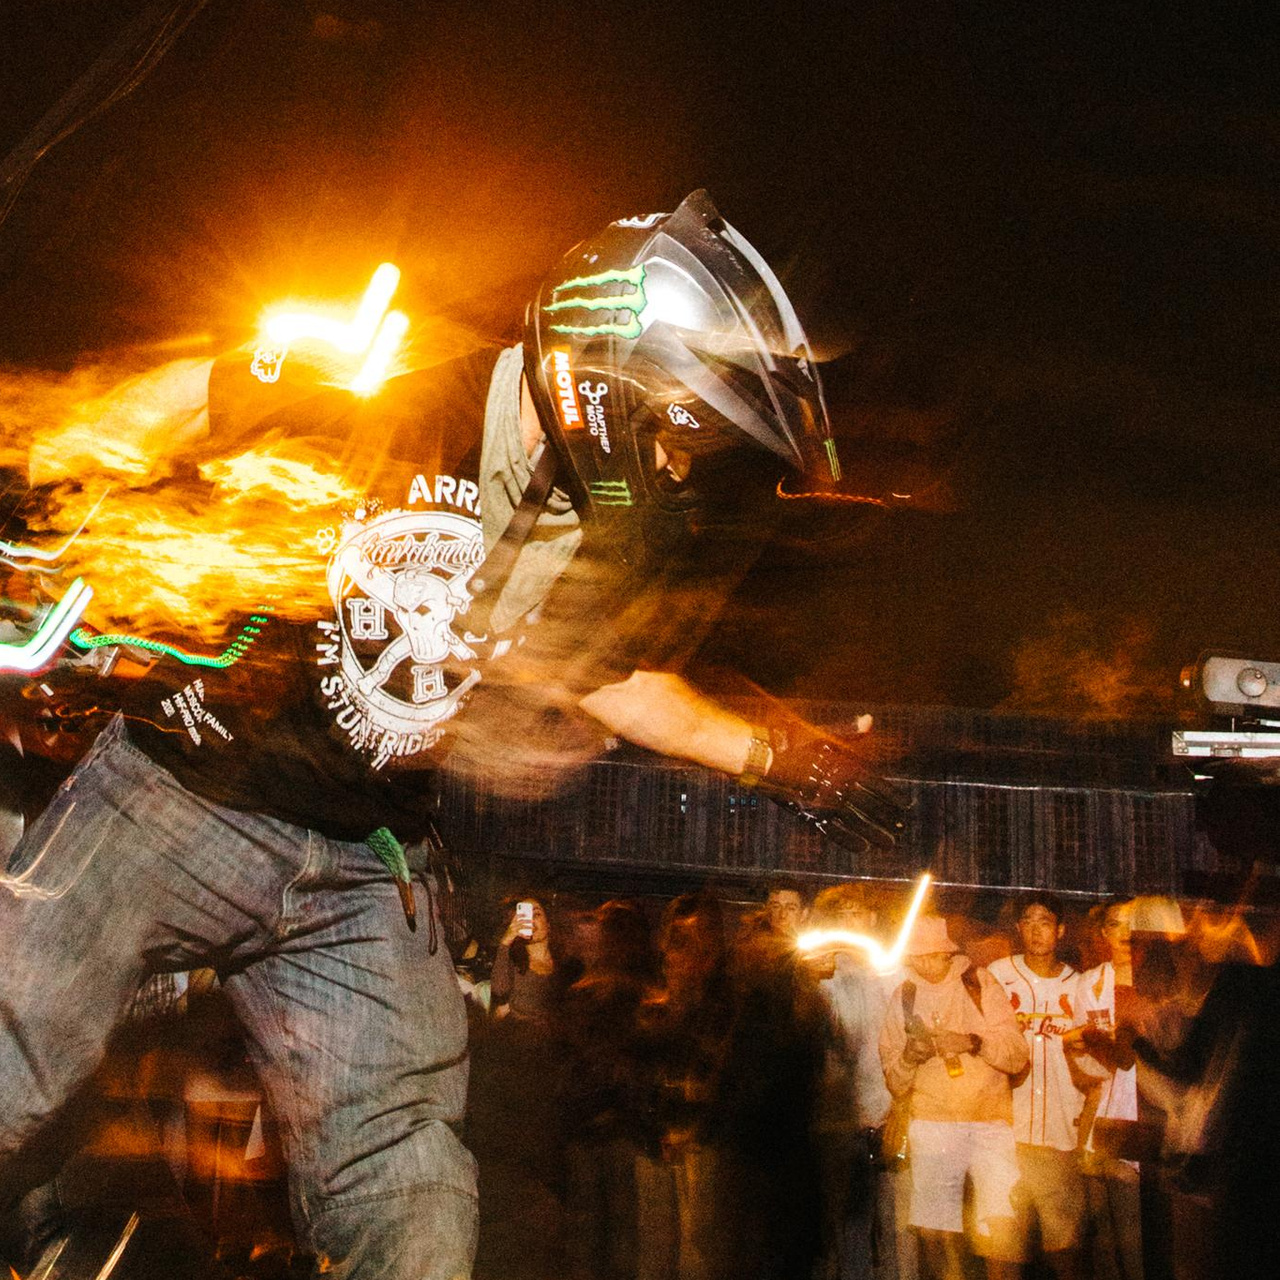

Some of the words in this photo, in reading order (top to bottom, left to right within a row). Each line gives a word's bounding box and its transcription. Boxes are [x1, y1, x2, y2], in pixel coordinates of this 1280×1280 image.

[554, 350, 580, 425] MOTUL
[316, 620, 340, 666] I'M
[203, 711, 234, 741] FAMILY
[1035, 1016, 1067, 1040] Loui
